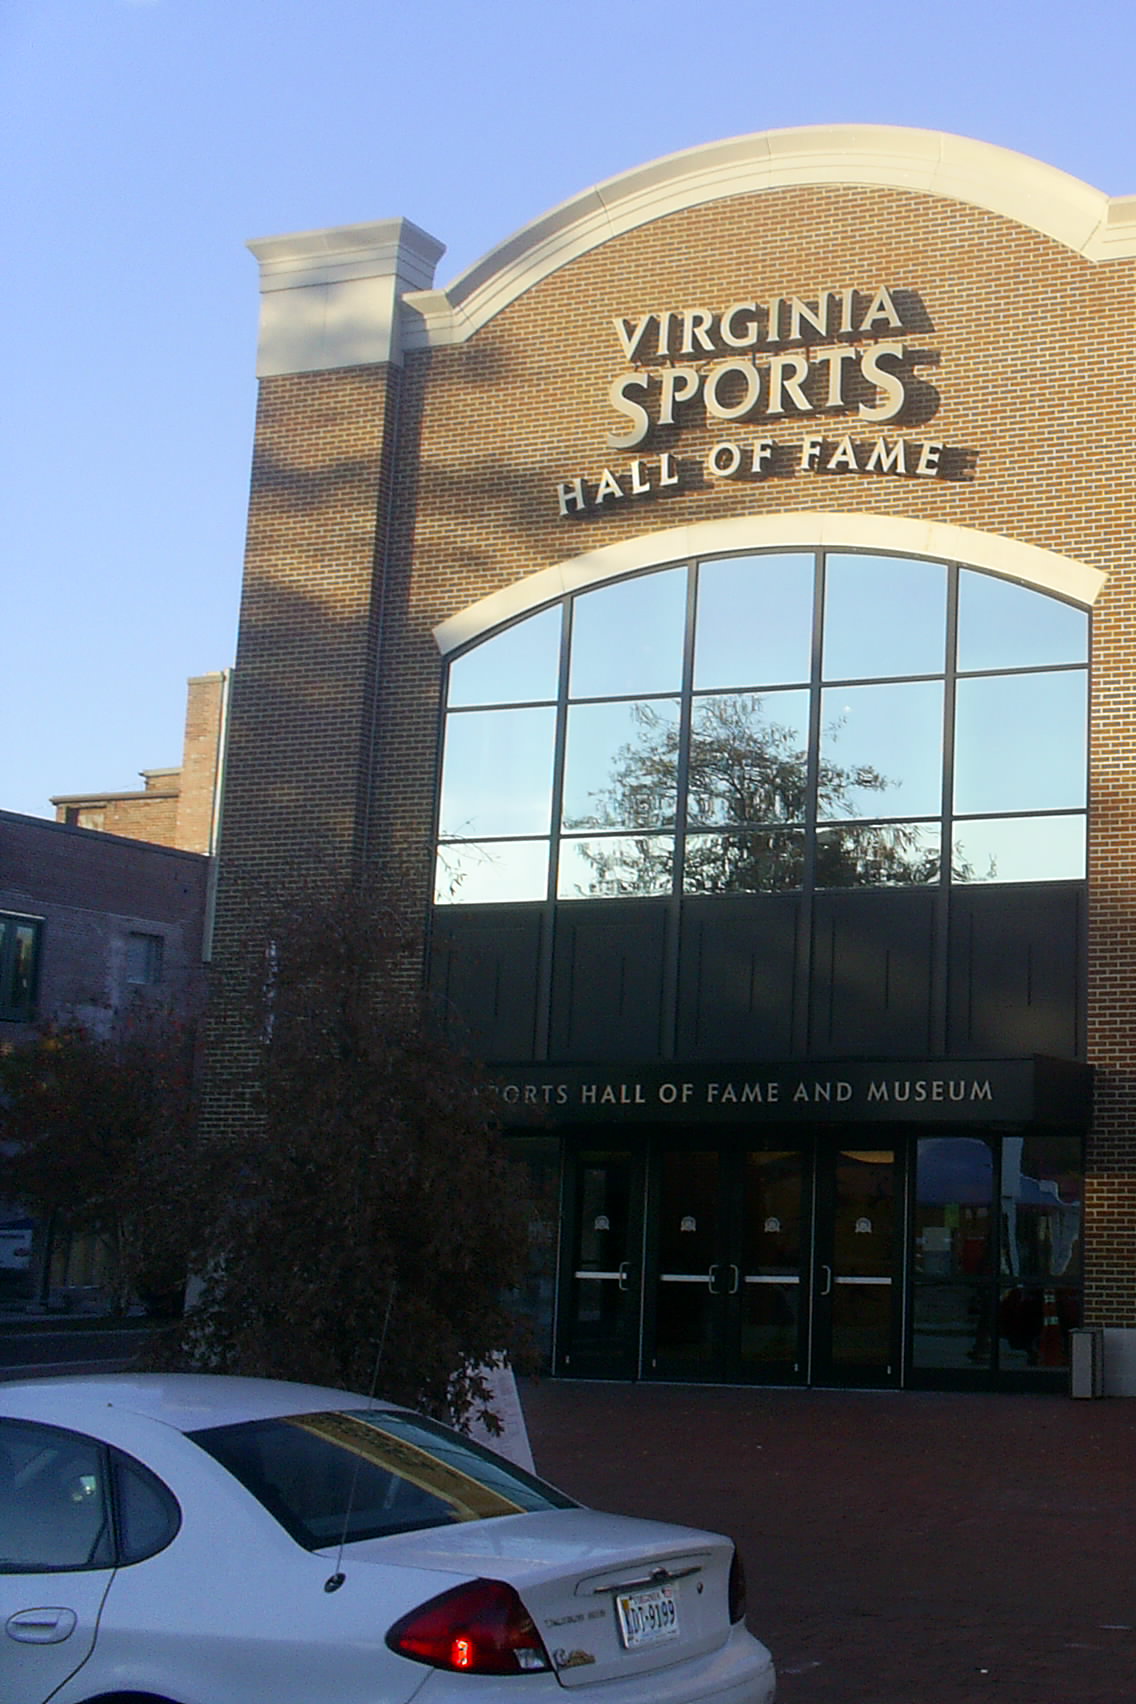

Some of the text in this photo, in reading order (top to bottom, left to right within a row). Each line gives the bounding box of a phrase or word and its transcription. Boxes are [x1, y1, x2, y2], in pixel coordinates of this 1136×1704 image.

[612, 285, 902, 361] VIRGINIA
[607, 343, 906, 450] SPORTS
[556, 435, 944, 517] HALL OF FAME
[581, 1084, 646, 1104] HALL
[658, 1083, 695, 1104] OF
[707, 1082, 779, 1103] FAME
[793, 1081, 853, 1102] AND
[867, 1080, 994, 1102] MUSEUM
